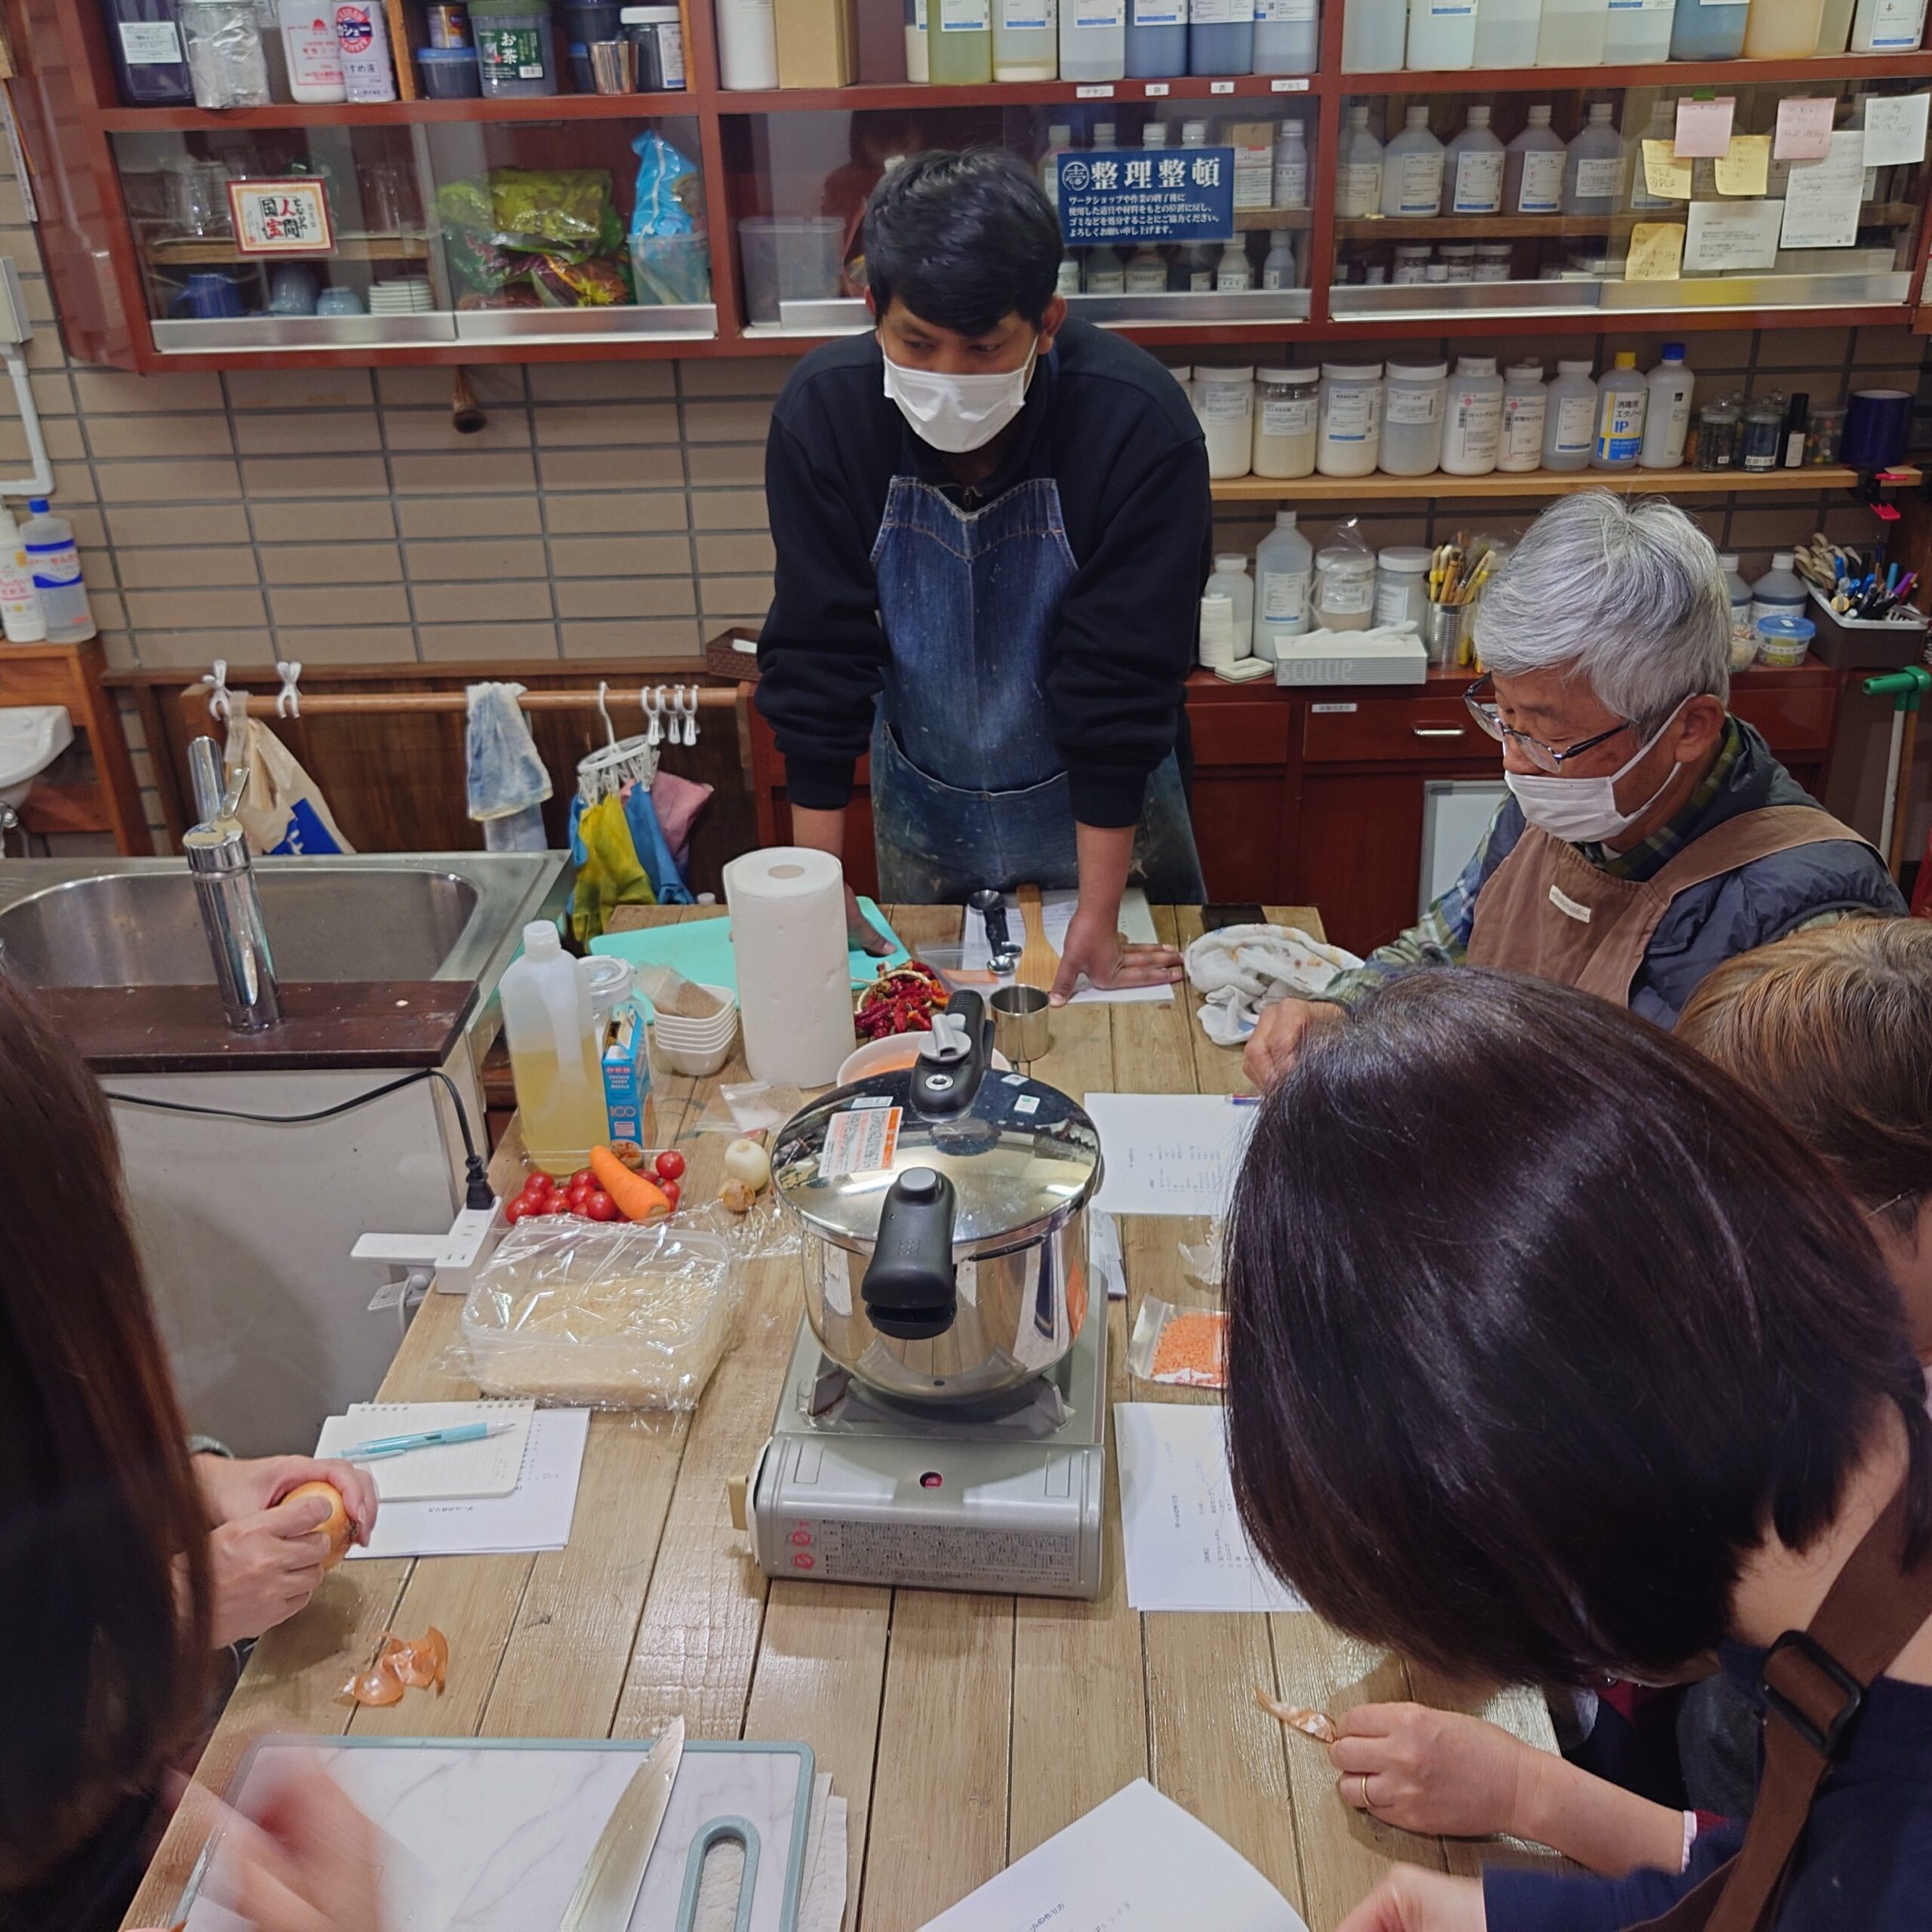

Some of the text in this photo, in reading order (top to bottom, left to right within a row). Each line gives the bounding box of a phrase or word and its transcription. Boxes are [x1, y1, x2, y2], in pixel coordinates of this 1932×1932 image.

[338, 25, 371, 37] カシュー
[501, 32, 518, 64] お茶
[1091, 158, 1220, 190] 整理整頓
[1069, 194, 1186, 206] ワークショップや作業の終了後に
[1069, 204, 1213, 217] 使用した道具や材料をもとの位置に戻し、
[1069, 214, 1220, 226] ゴミなどを処分することにご協力ください。
[1069, 226, 1174, 238] よろしくお願い申し上げます。
[1617, 400, 1638, 409] 消毒用
[1615, 421, 1629, 433] IP
[1283, 660, 1352, 682] scottie
